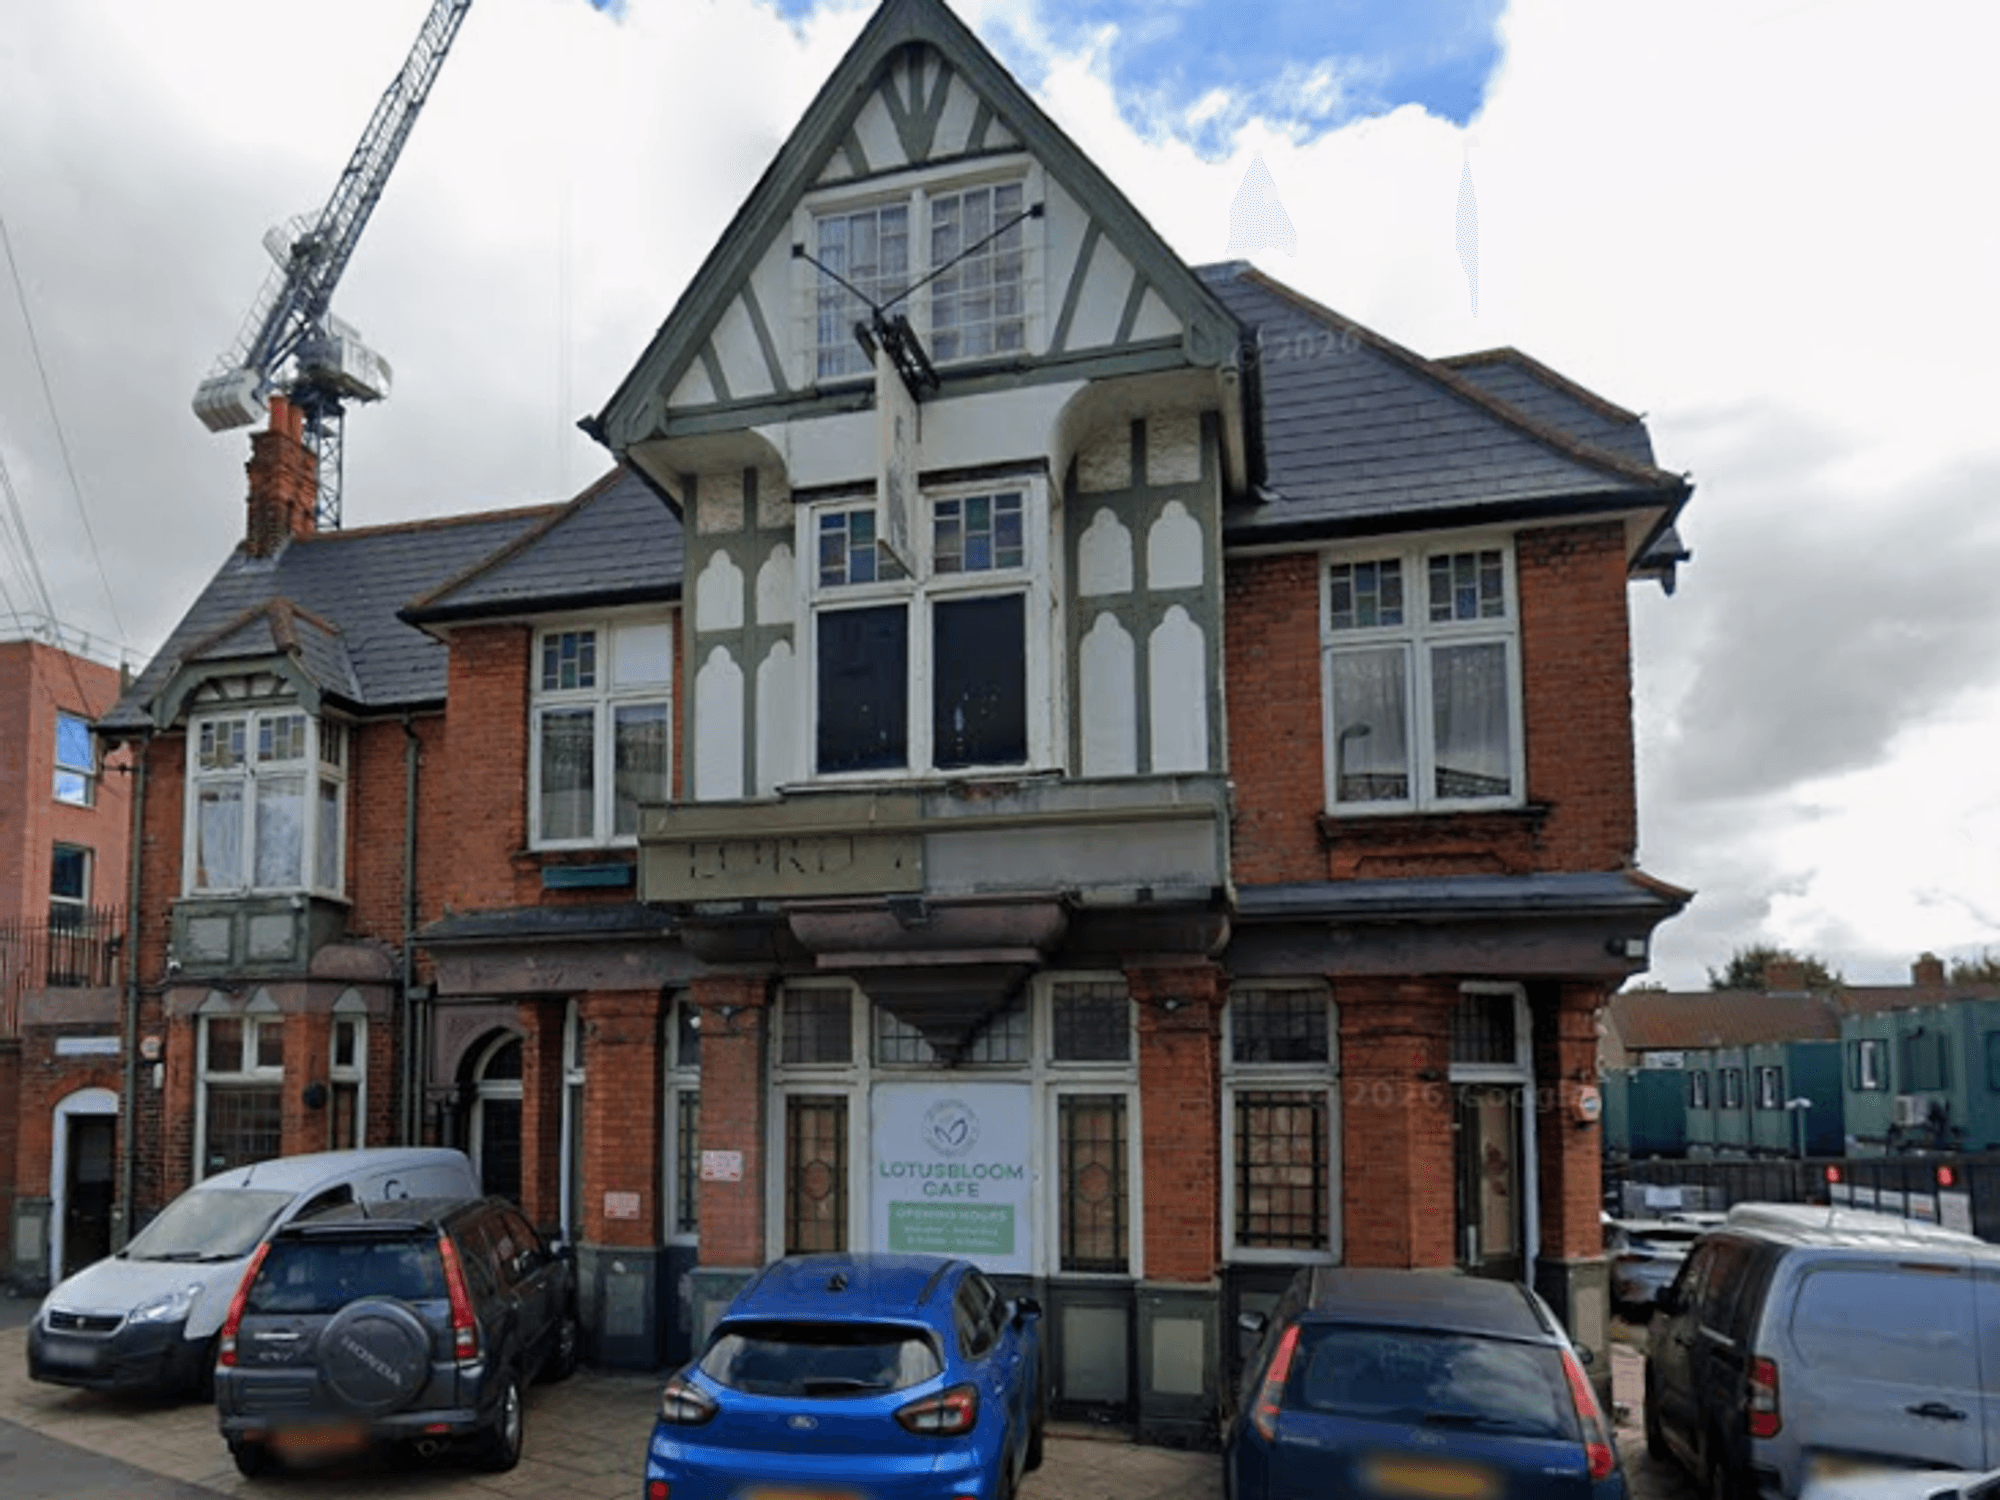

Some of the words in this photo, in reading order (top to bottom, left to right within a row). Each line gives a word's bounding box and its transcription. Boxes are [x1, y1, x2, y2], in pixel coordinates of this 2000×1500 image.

[879, 1161, 1025, 1180] LOTUSBLOOM
[922, 1181, 980, 1198] CAFE
[341, 1335, 401, 1386] HONDA
